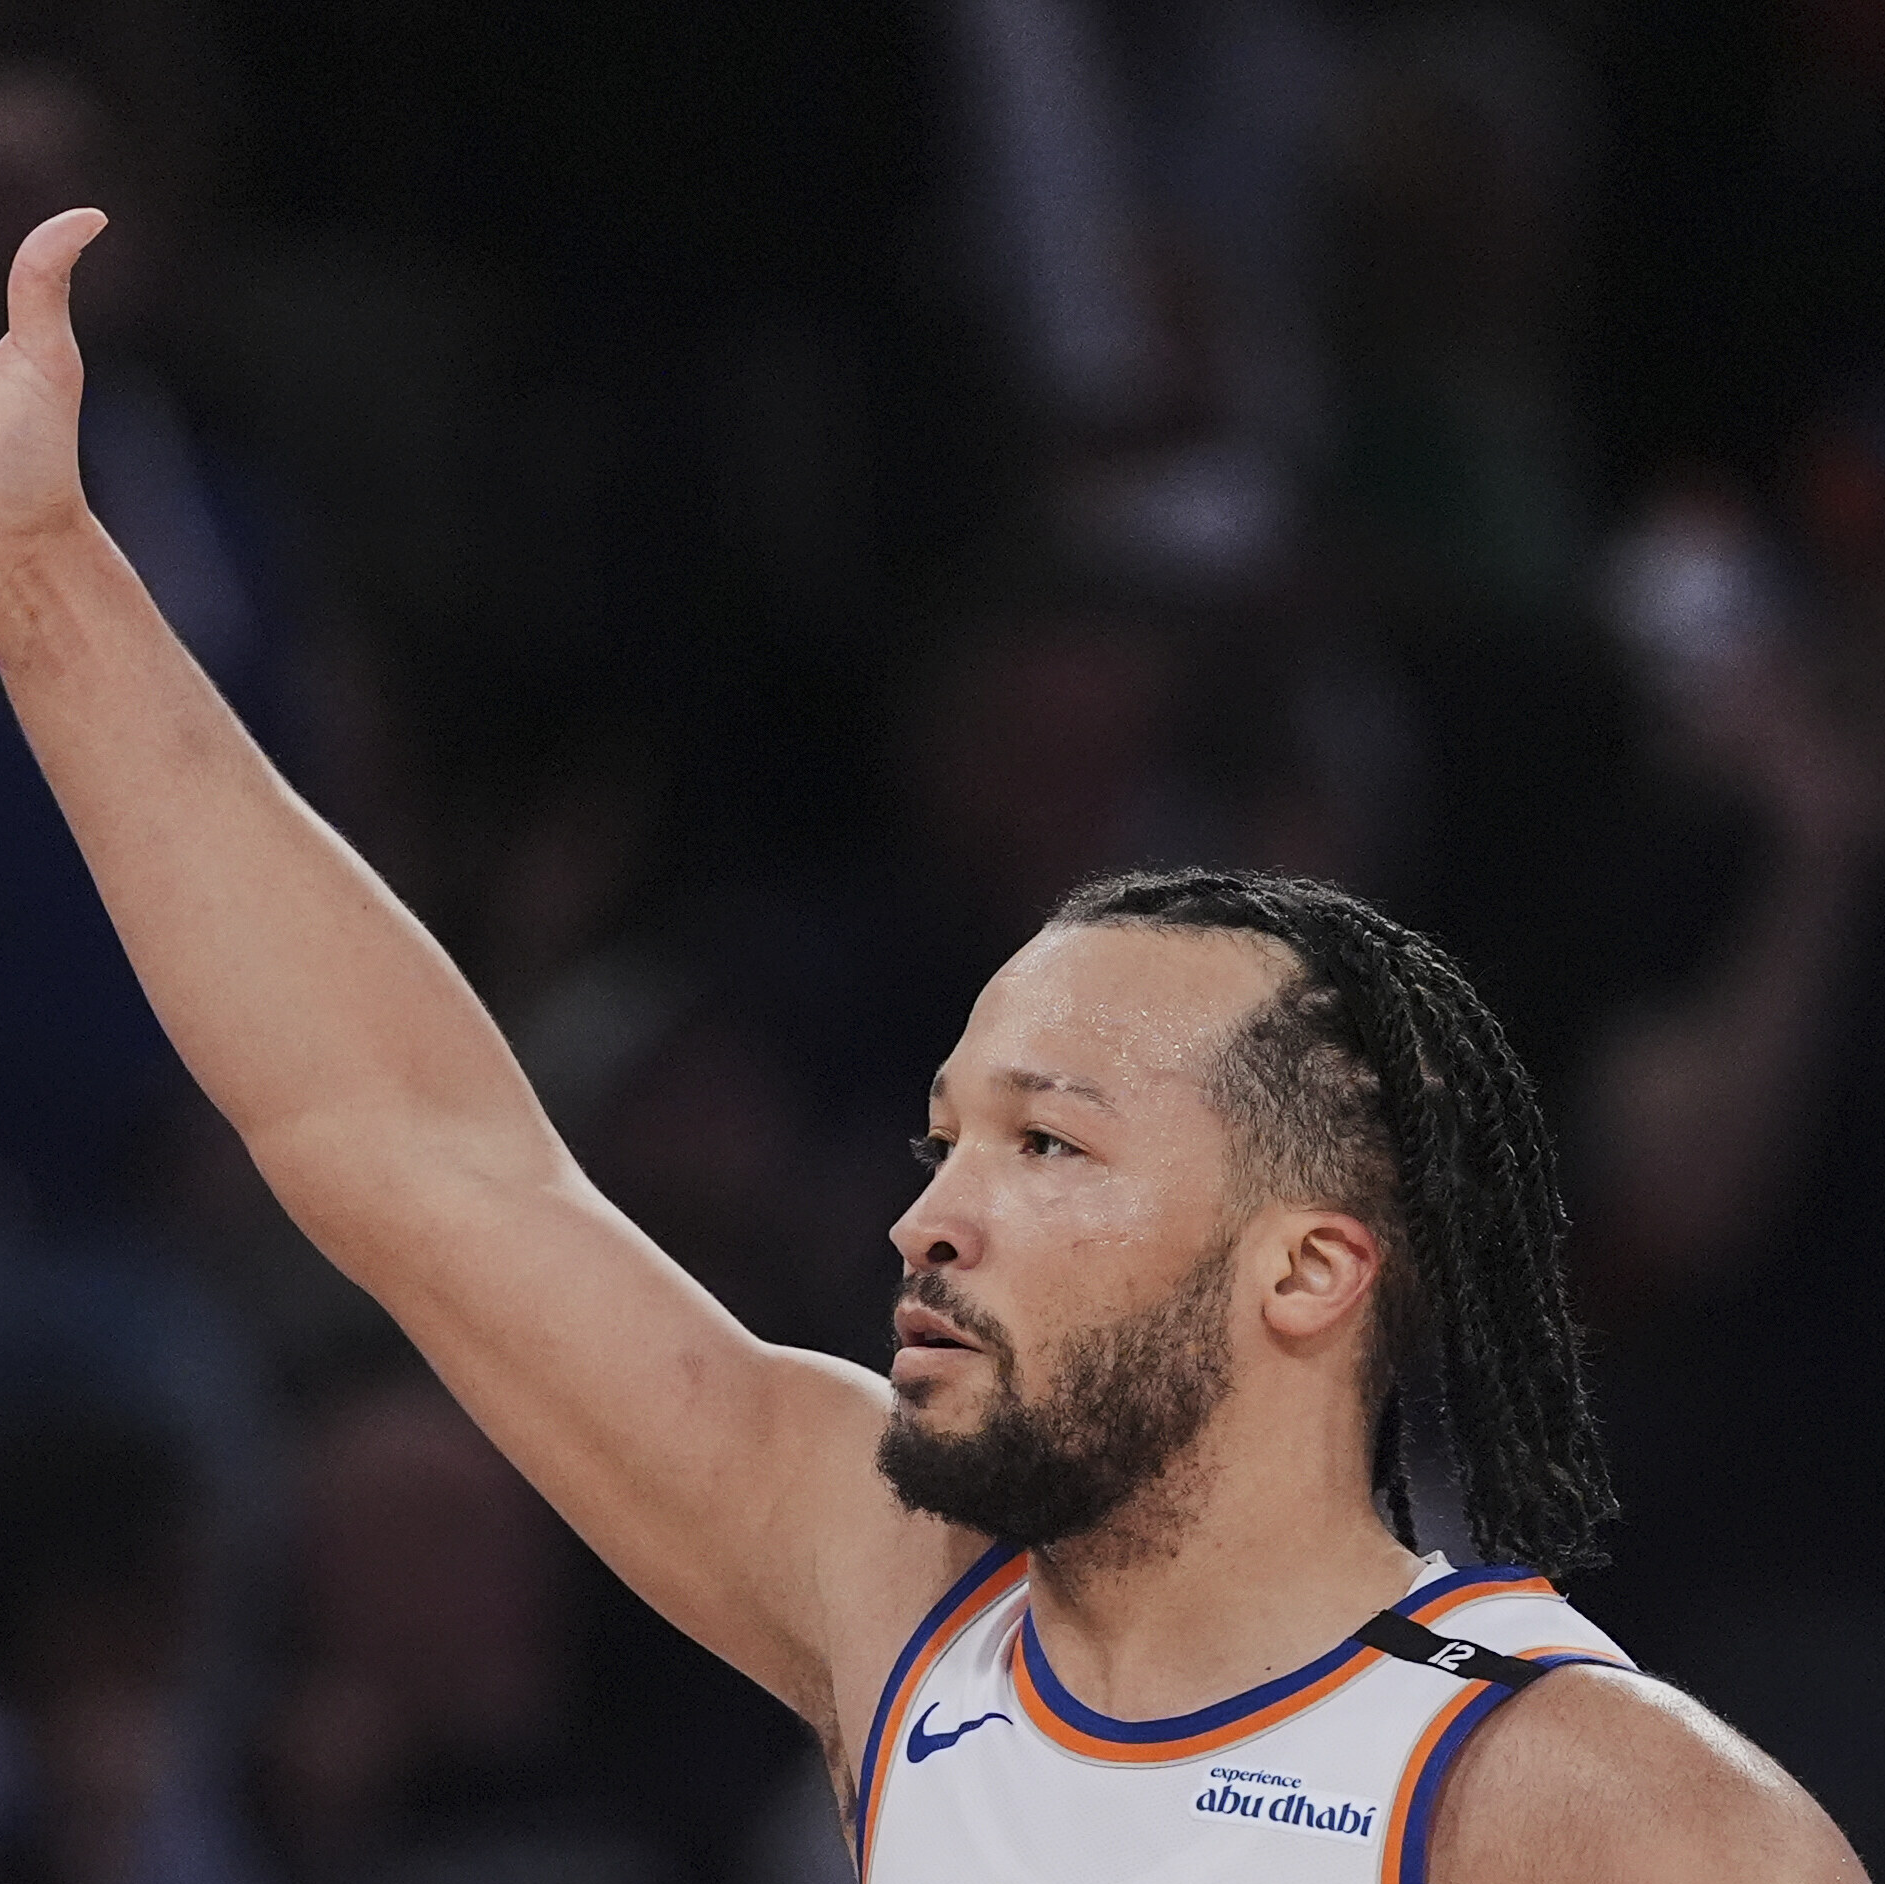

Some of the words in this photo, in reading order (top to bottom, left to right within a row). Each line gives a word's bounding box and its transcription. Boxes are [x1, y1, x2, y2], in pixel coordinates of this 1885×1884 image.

[1426, 1641, 1476, 1672] 12
[1210, 1766, 1302, 1789] experience
[1195, 1784, 1265, 1819] abu
[1268, 1793, 1377, 1837] dhabi
